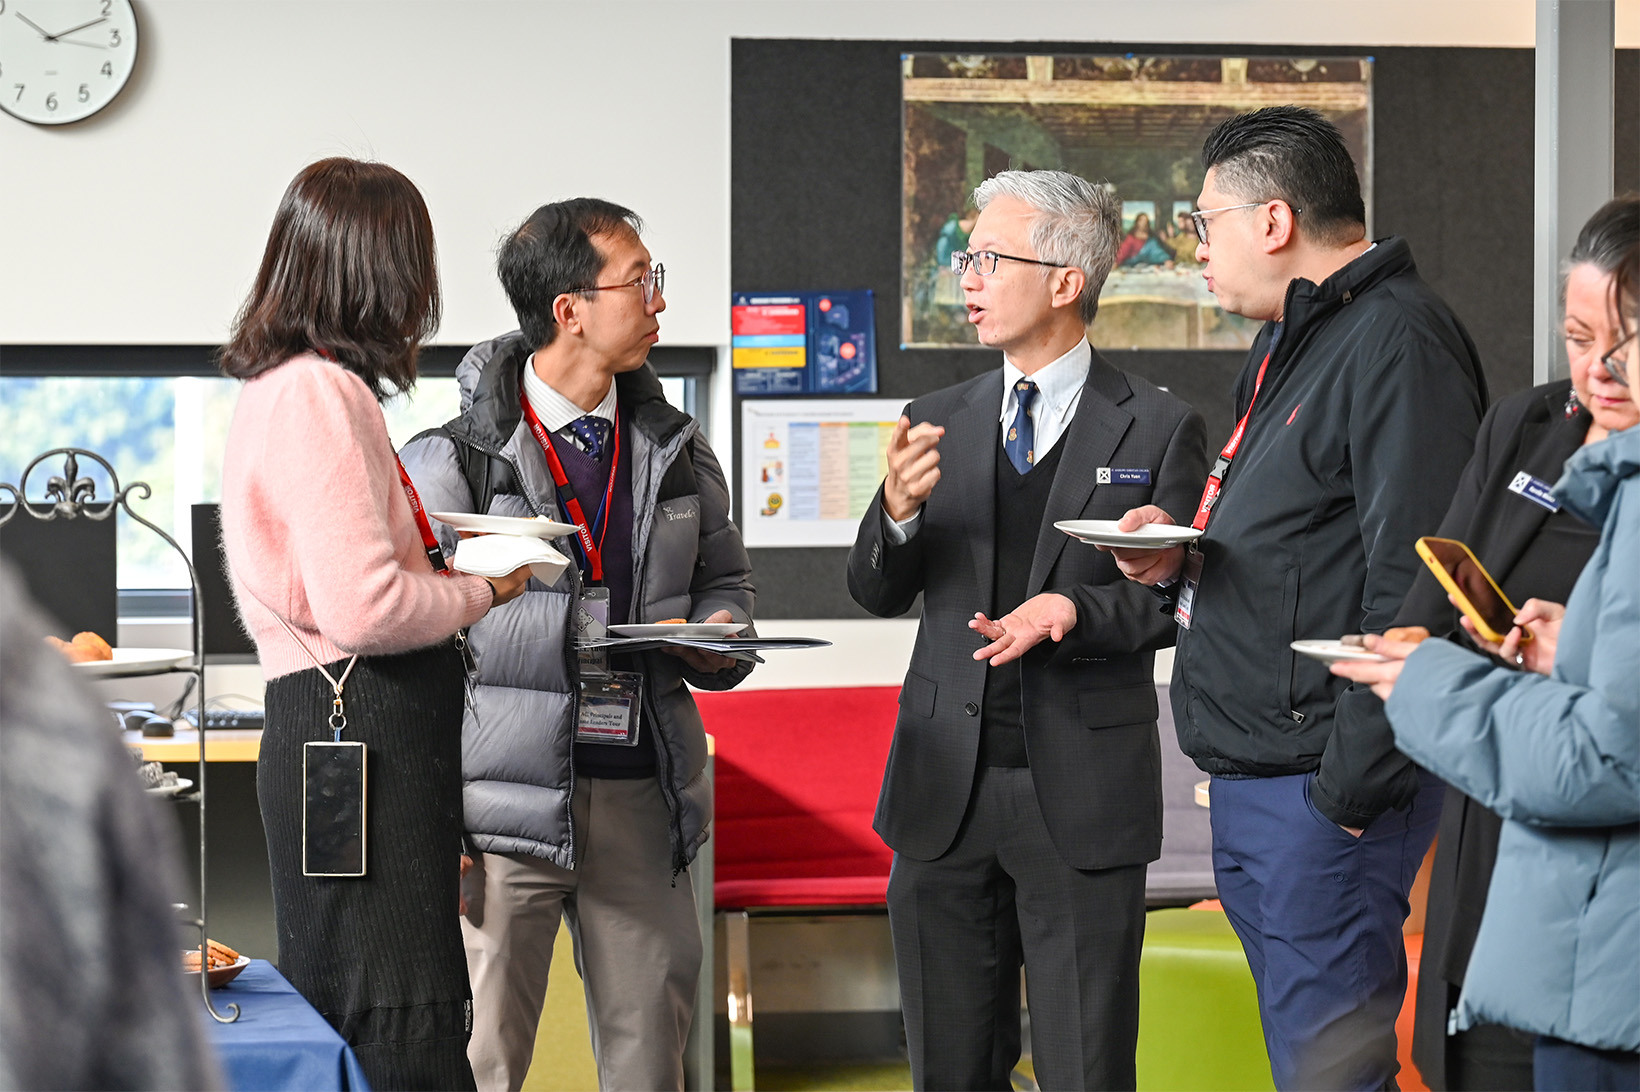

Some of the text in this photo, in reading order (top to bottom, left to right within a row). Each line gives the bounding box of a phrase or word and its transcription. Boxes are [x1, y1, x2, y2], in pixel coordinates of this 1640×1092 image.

[100, 0, 112, 16] 2
[109, 29, 121, 48] 3
[100, 60, 113, 78] 4
[14, 83, 25, 101] 7
[45, 92, 58, 111] 6
[78, 83, 90, 103] 5
[533, 422, 550, 451] VISITOR
[1225, 425, 1244, 454] VISITOR
[579, 523, 593, 552] VISITOR
